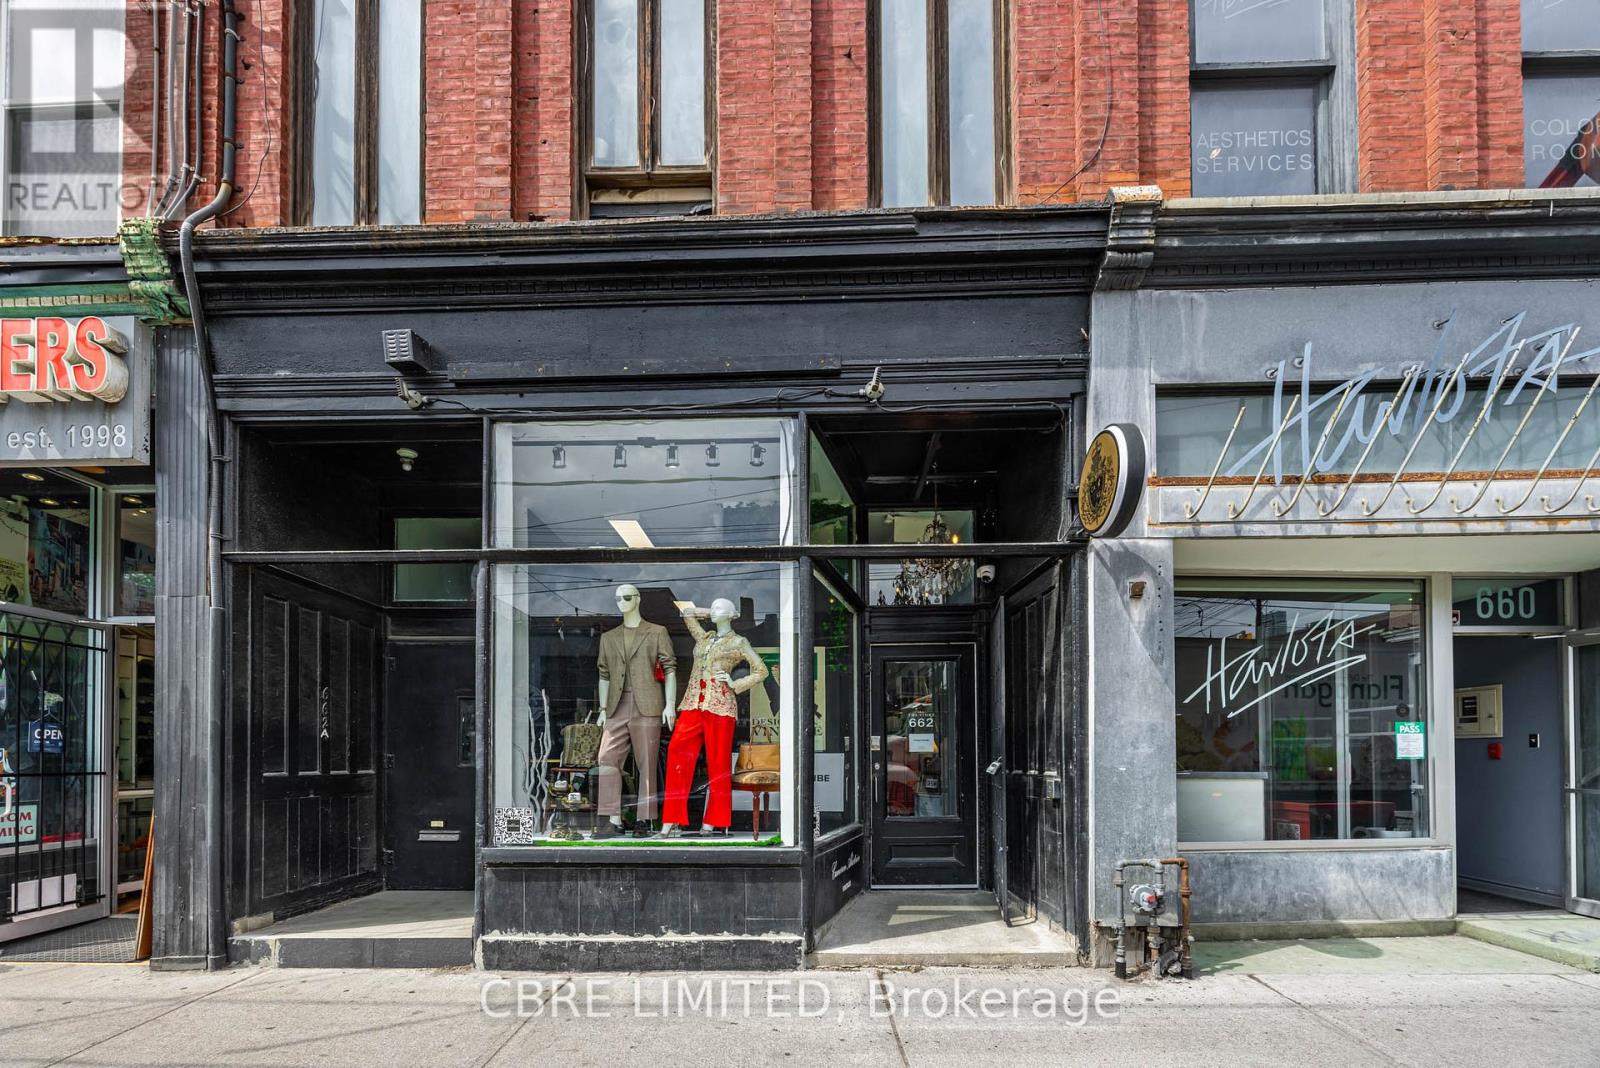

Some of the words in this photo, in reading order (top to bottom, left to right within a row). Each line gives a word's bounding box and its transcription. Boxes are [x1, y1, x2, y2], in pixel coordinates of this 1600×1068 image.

[1196, 130, 1311, 149] AESTHETICS
[1197, 153, 1312, 173] SERVICES
[7, 427, 54, 449] est.
[66, 424, 126, 448] 1998
[1476, 586, 1535, 619] 660
[752, 718, 780, 726] DESI
[909, 718, 934, 728] 662
[34, 728, 64, 740] OPEN
[1399, 725, 1420, 734] PASS
[814, 774, 831, 782] BE
